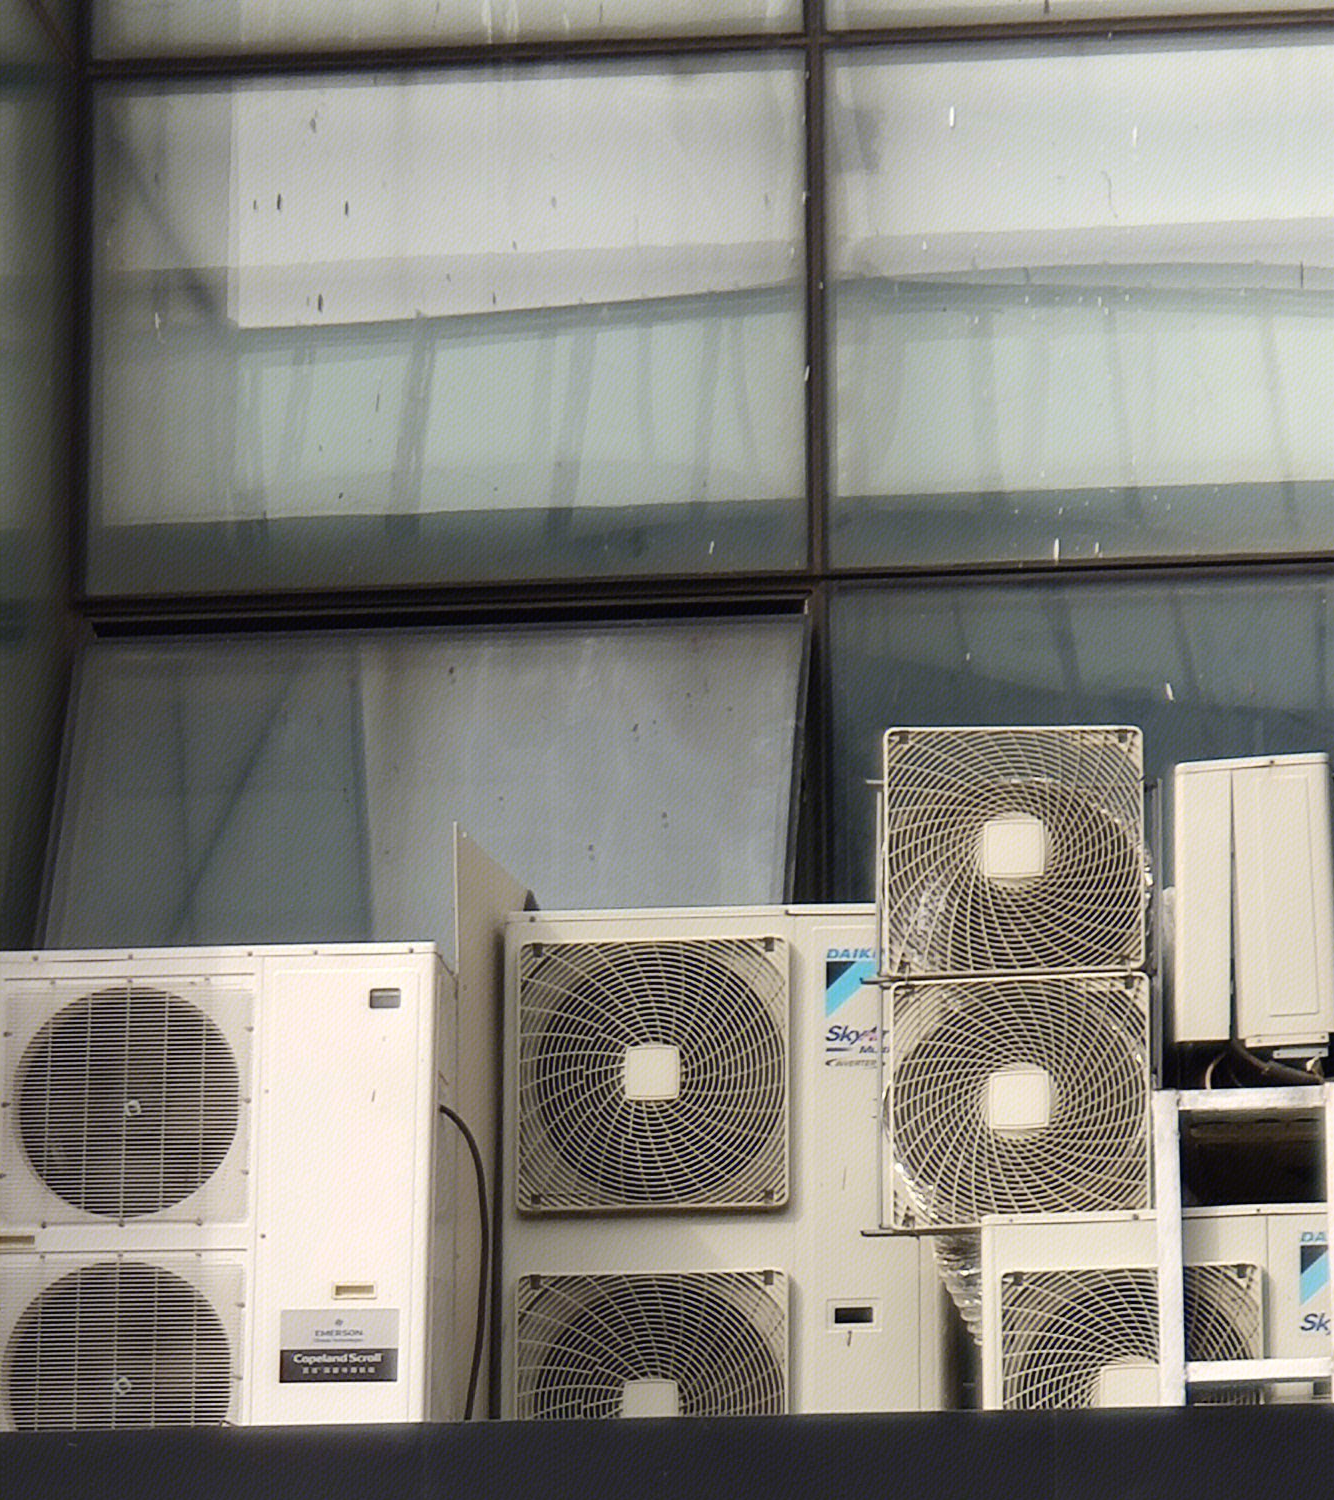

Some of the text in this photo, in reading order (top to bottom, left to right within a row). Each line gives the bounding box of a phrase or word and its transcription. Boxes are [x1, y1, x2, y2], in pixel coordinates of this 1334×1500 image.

[826, 947, 878, 959] DAIKI
[314, 1329, 364, 1338] EMERSON
[293, 1352, 383, 1365] Copeland Scroll
